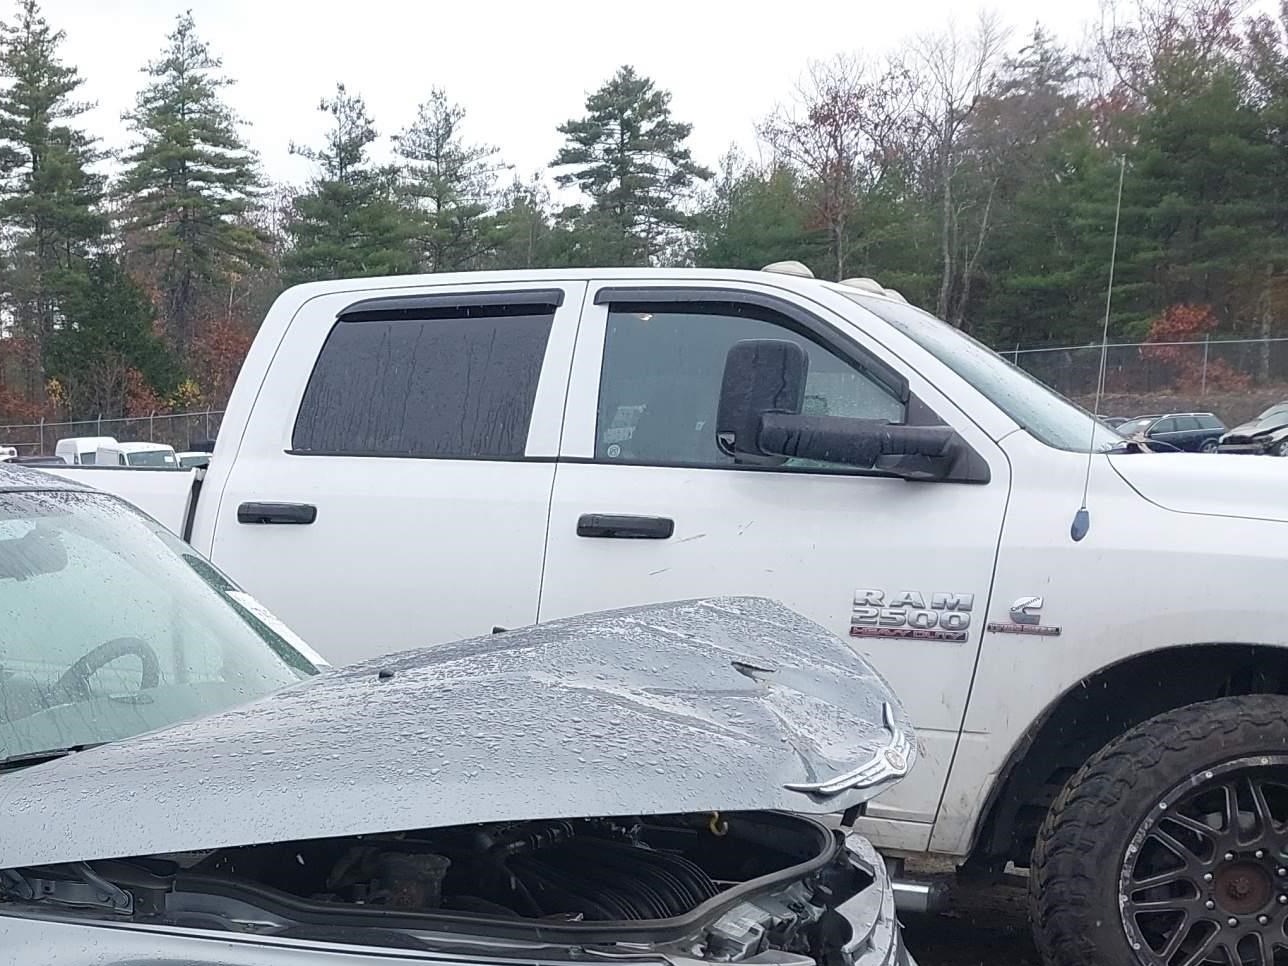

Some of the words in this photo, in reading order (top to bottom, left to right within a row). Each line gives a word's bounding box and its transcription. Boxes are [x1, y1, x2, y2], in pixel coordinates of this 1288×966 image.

[853, 588, 974, 612] RAM
[850, 607, 971, 631] 2500
[852, 626, 911, 638] HEAVY
[912, 629, 966, 641] DUTY
